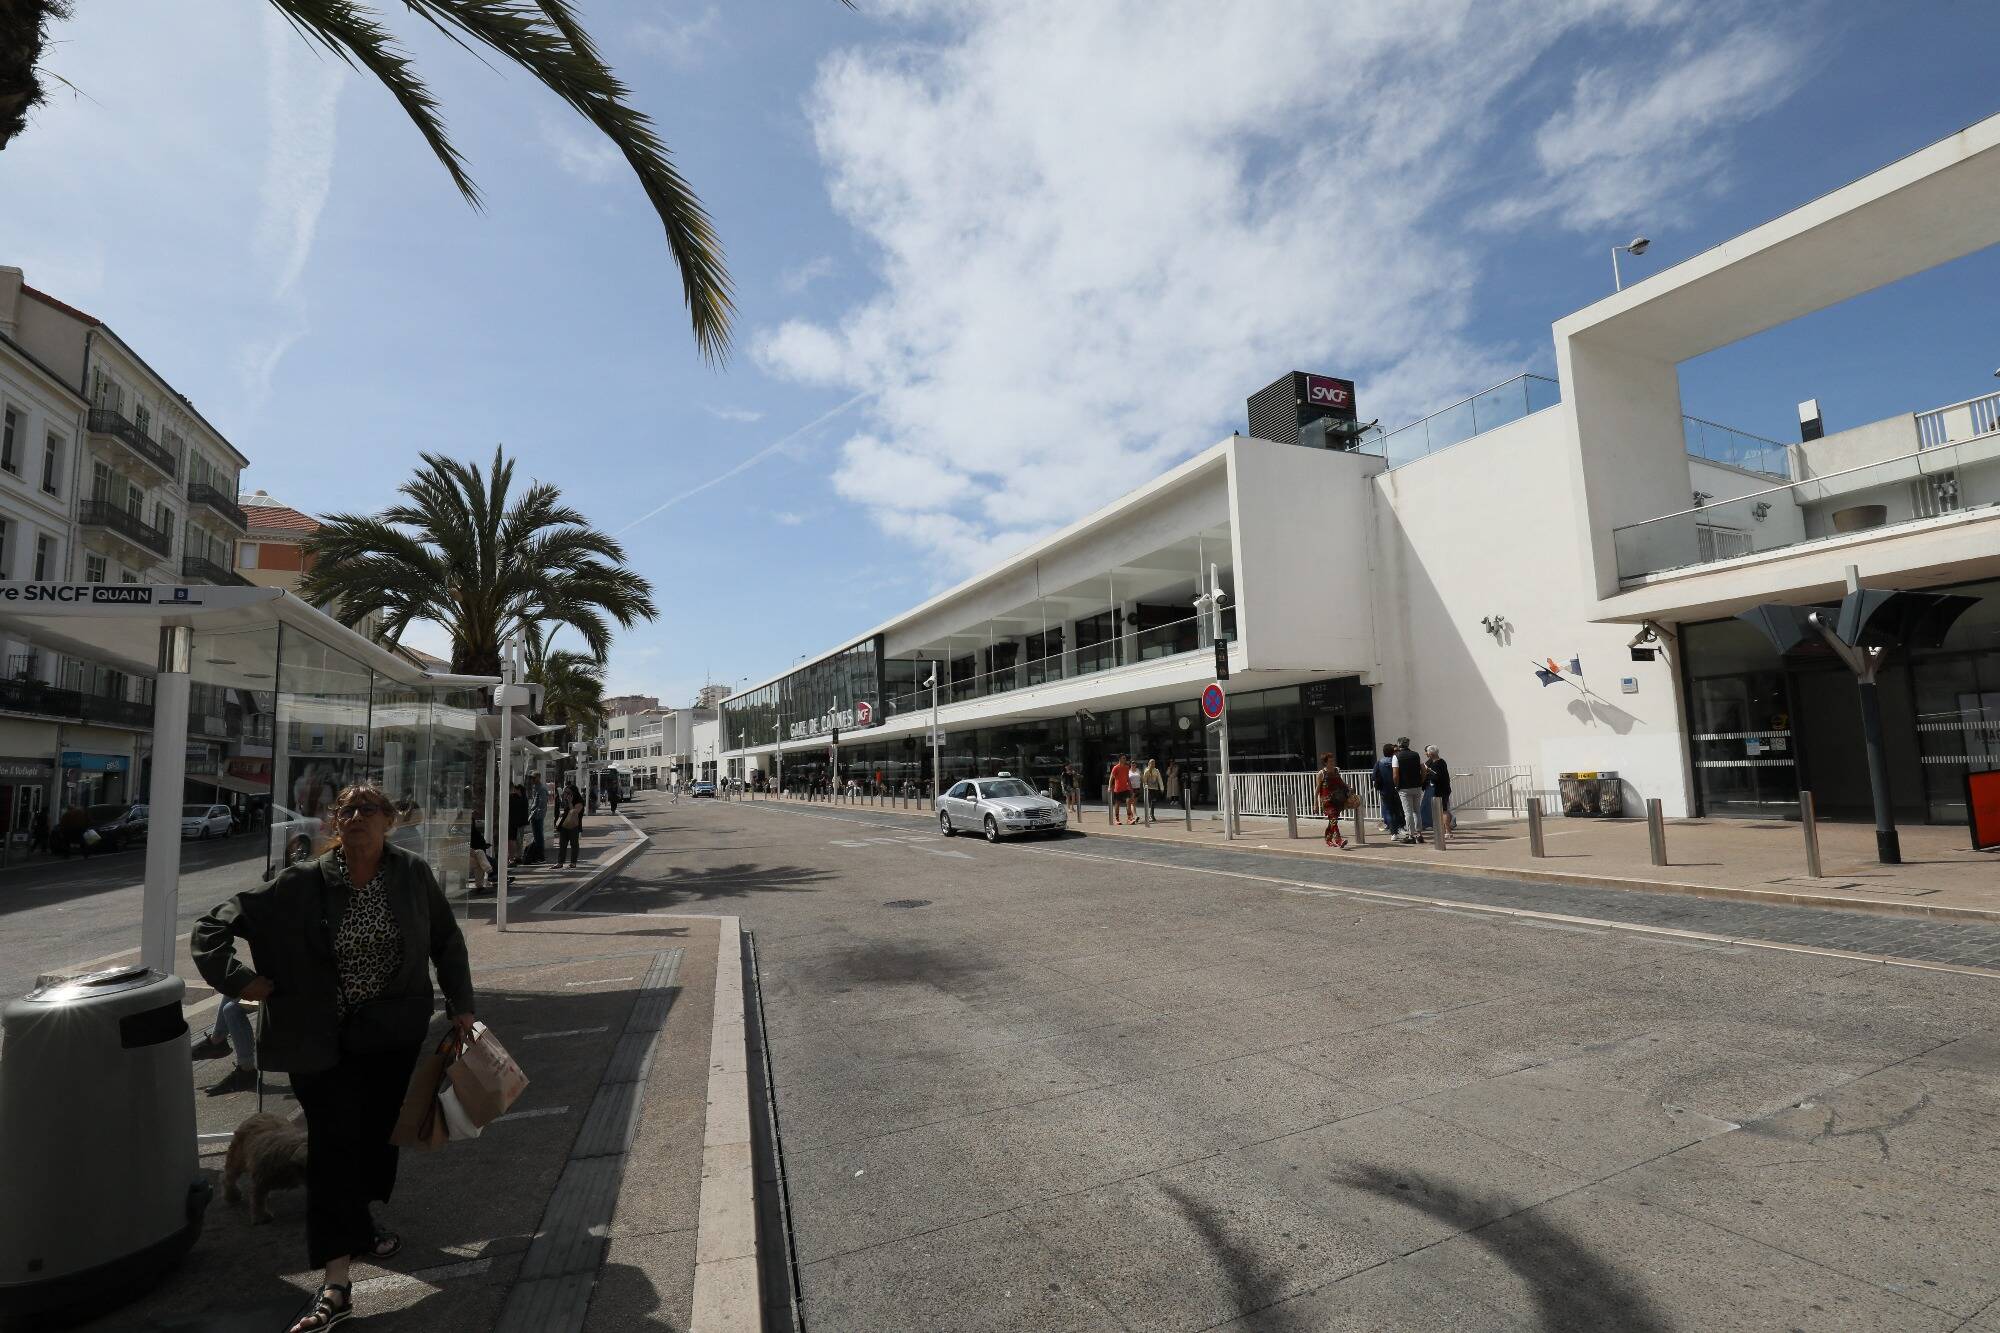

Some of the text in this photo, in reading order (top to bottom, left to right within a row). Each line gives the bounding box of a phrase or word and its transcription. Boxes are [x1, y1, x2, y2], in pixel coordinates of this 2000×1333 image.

[1312, 387, 1347, 402] SNCF
[23, 585, 90, 601] SNCF
[95, 589, 135, 601] QUAI
[790, 709, 854, 738] GARE DE CANES
